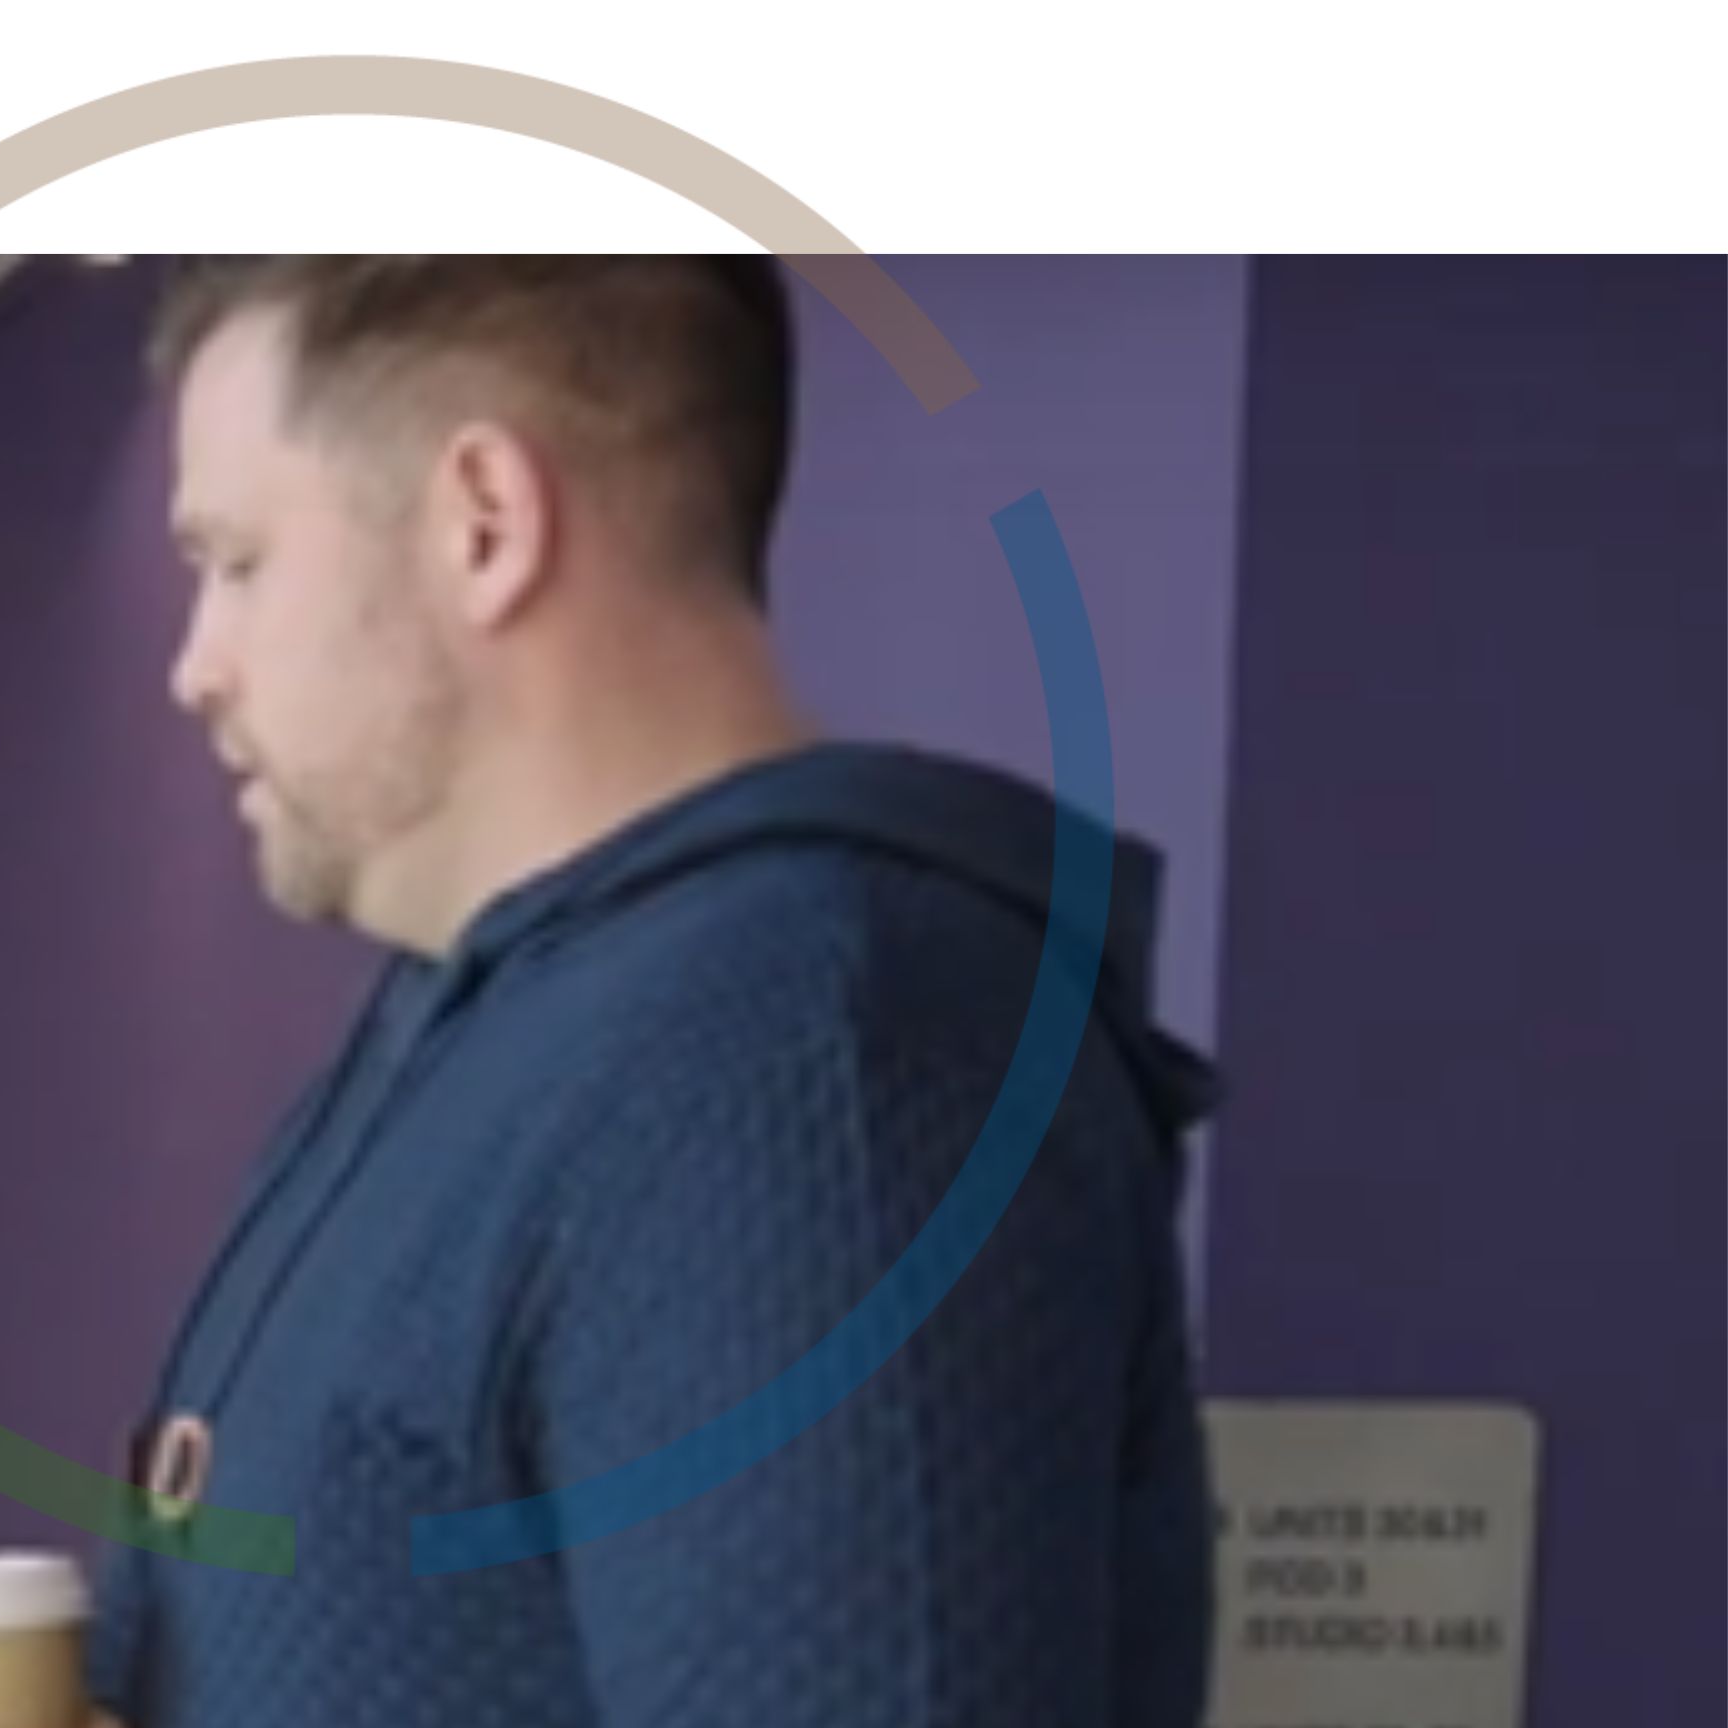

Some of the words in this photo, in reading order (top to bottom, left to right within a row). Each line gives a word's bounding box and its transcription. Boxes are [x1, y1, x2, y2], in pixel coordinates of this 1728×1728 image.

[1247, 1504, 1365, 1540] UNITS
[1244, 1557, 1336, 1597] POD
[1242, 1614, 1394, 1652] STUDIO
